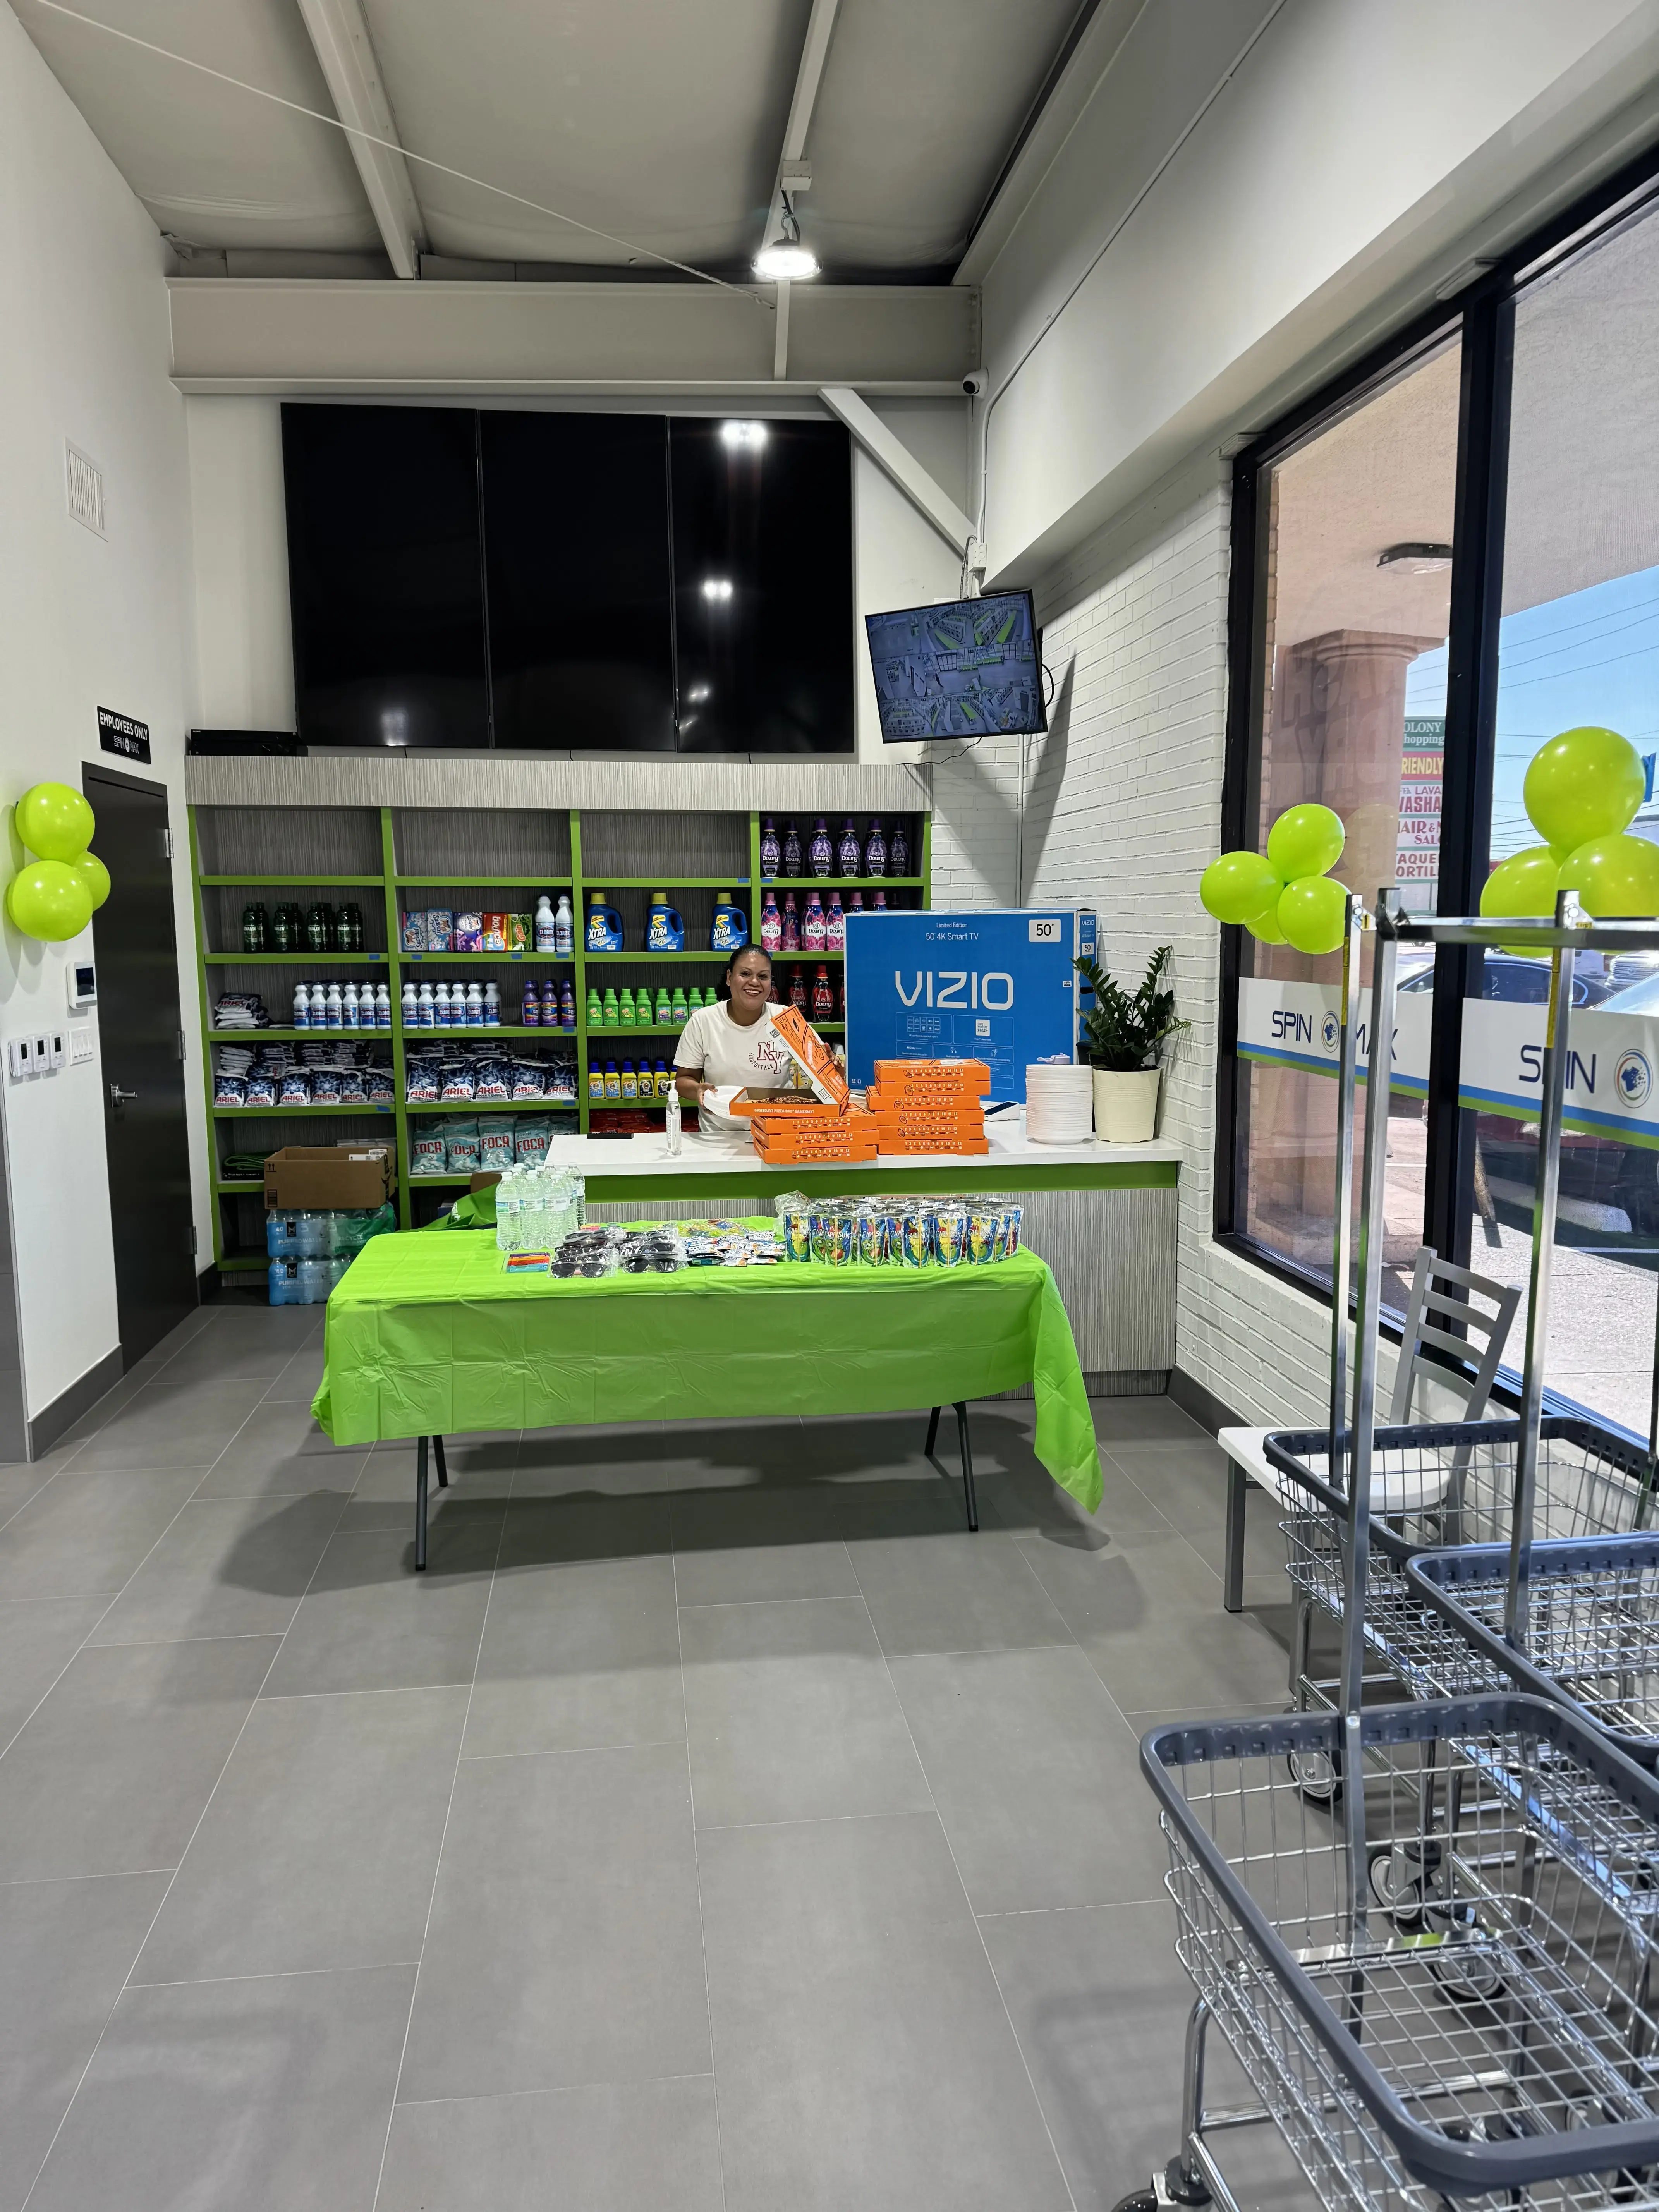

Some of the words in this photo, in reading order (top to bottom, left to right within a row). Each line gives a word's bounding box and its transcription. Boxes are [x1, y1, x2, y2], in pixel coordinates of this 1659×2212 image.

[99, 711, 133, 735] EMPLOYEES
[134, 725, 147, 741] ONLY
[1429, 823, 1436, 832] &
[1397, 853, 1437, 864] AQUE
[433, 915, 443, 935] Suavitel
[492, 916, 501, 945] bounce
[1036, 924, 1054, 936] 50"
[413, 928, 423, 948] Suavitel
[588, 927, 606, 940] XTRA
[649, 927, 667, 940] XTRA
[713, 926, 730, 940] XTRA
[895, 970, 1014, 1010] VIZIO
[1271, 1010, 1312, 1043] SPIN
[749, 1052, 774, 1070] AEROPOSTALE
[757, 1041, 784, 1074] NY
[1519, 1044, 1597, 1094] SIN
[410, 1091, 438, 1099] ARIEL
[477, 1086, 505, 1094] ARIEL
[414, 1141, 442, 1156] FOCA
[450, 1145, 475, 1155] FOCA
[482, 1136, 509, 1150] FOCA
[517, 1137, 545, 1152] FOCA
